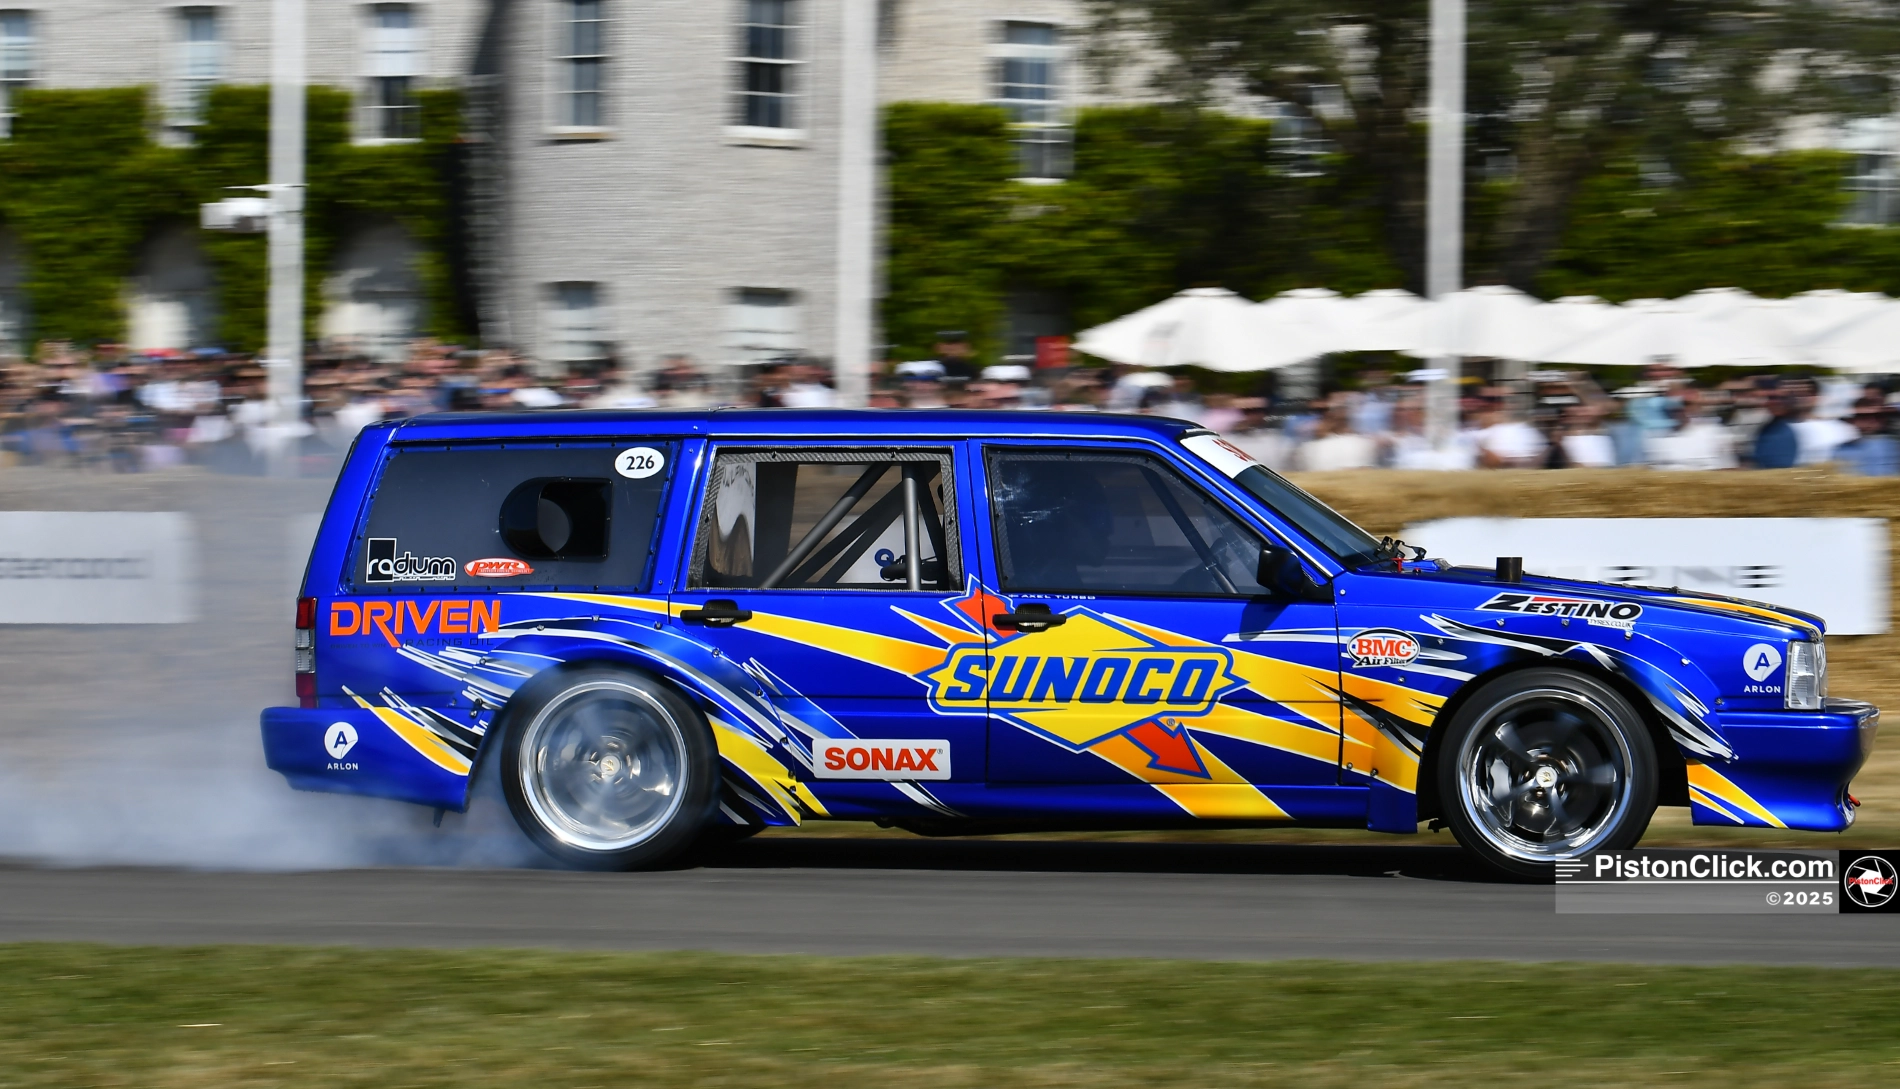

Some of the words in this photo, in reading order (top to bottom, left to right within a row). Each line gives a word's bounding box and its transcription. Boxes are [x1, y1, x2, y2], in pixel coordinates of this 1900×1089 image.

[625, 454, 656, 472] 226
[367, 551, 457, 577] radium
[470, 561, 520, 577] PWR
[1480, 593, 1642, 621] ZESTINO
[329, 600, 501, 648] DRIVEN
[405, 638, 463, 648] RACING
[469, 637, 494, 646] OIL
[1356, 638, 1412, 657] BMC
[1355, 656, 1383, 666] Air
[1384, 657, 1407, 666] Filter
[943, 654, 1219, 706] SUNOCO
[1743, 685, 1781, 694] ARLON
[326, 762, 359, 771] ARLON
